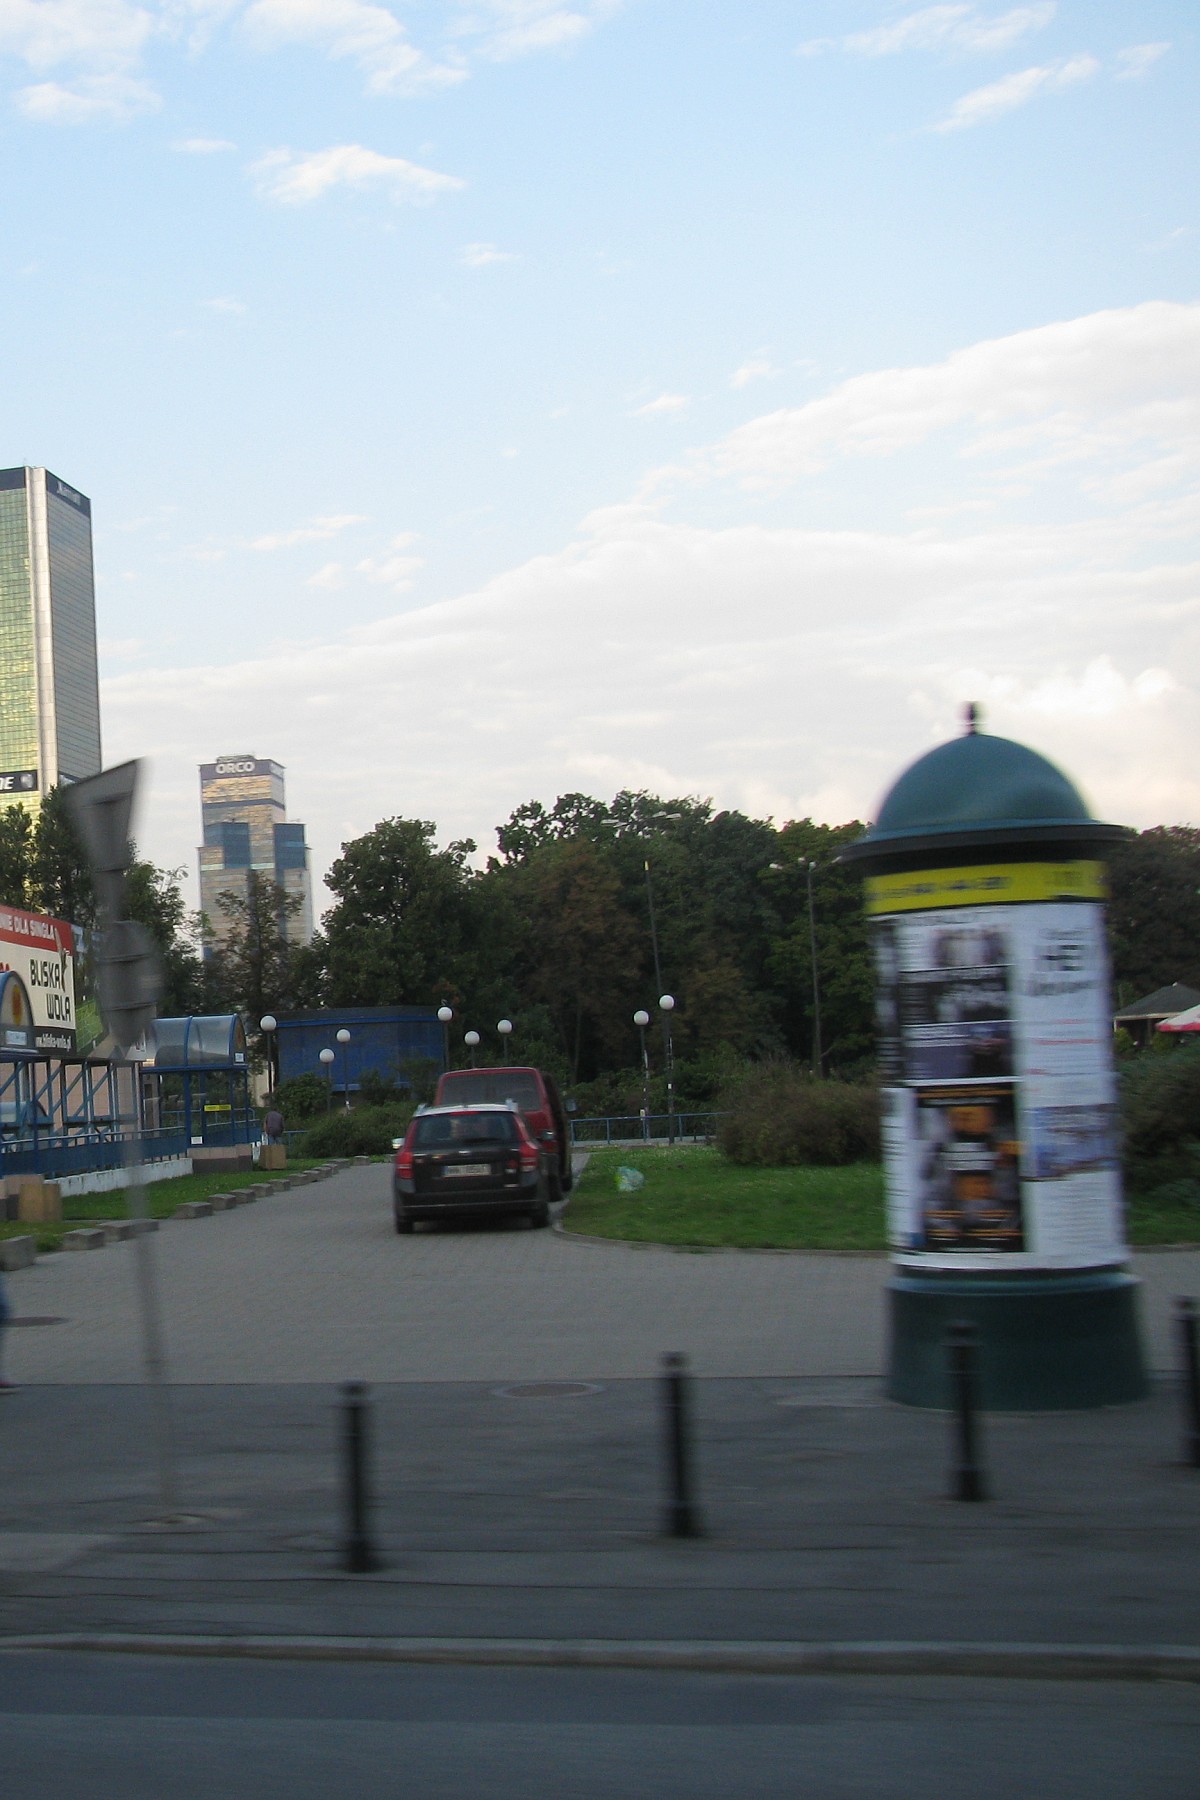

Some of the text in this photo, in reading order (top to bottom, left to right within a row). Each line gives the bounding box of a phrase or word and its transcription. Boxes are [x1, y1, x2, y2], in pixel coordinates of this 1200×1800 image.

[215, 761, 255, 774] ORCO
[30, 959, 61, 989] BLISKA
[46, 994, 72, 1022] WOLA
